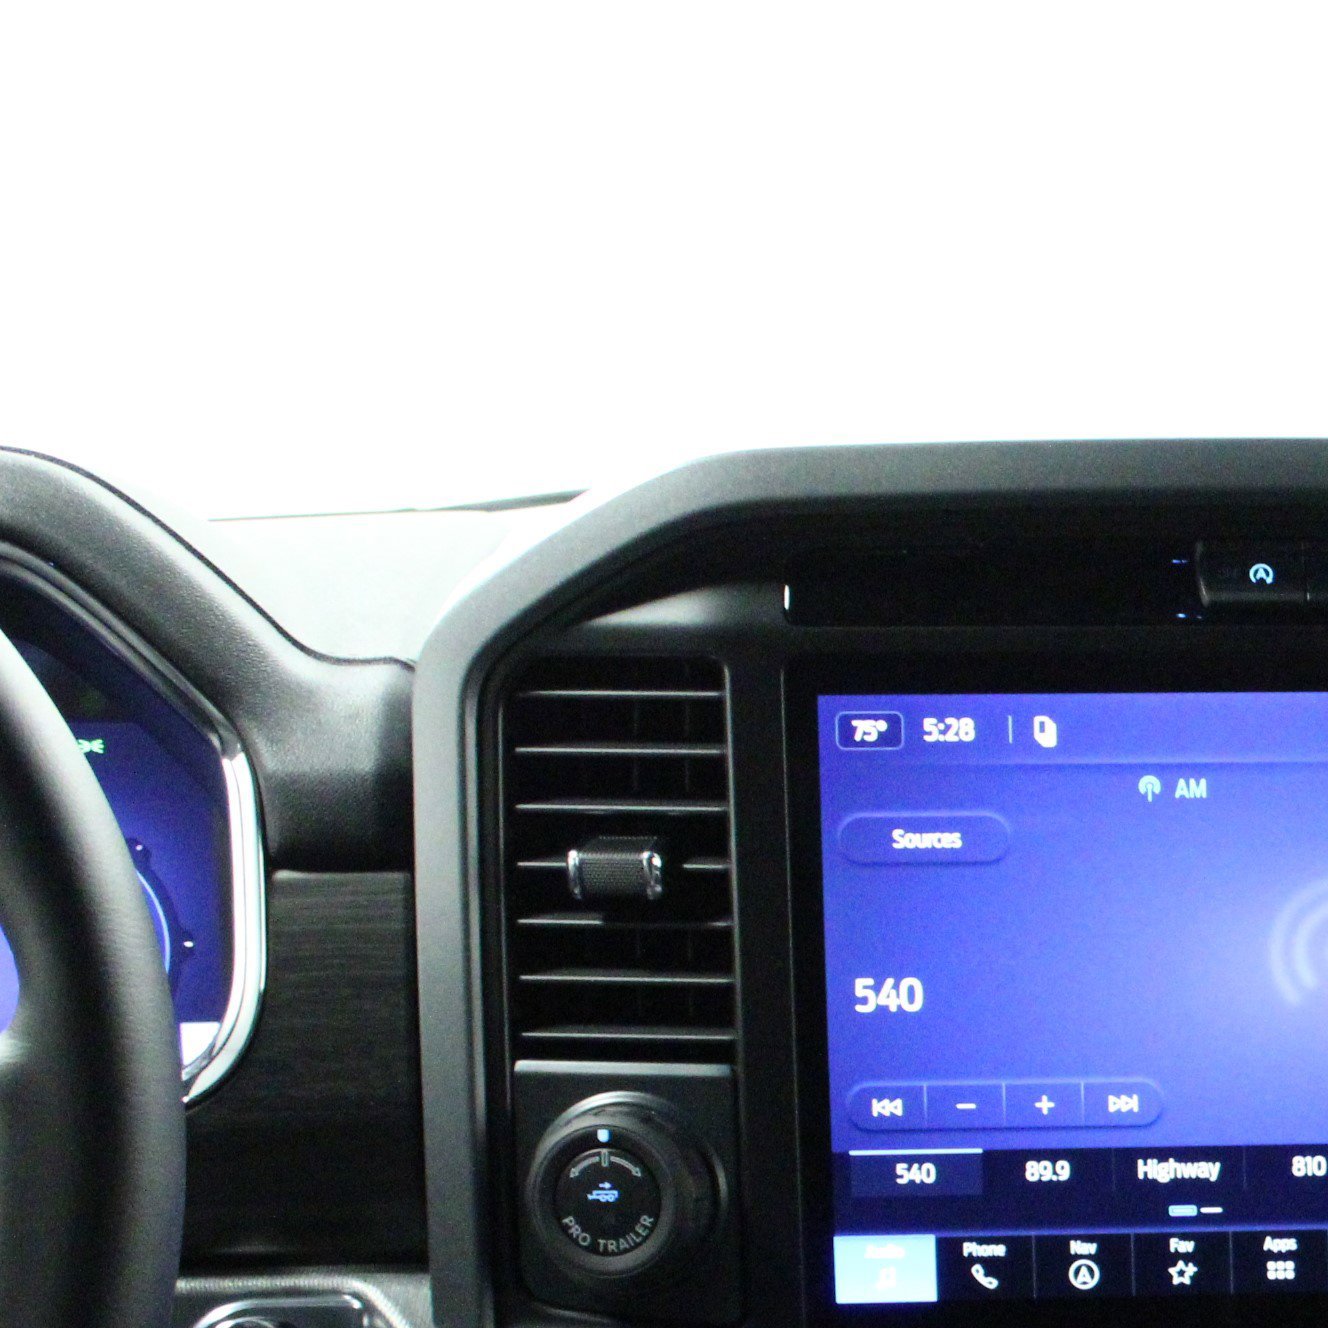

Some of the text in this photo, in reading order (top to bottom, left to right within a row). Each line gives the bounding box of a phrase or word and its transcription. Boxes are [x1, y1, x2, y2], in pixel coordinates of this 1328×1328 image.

[923, 718, 975, 742] 5:28
[1175, 779, 1207, 800] AM
[892, 829, 962, 850] Sources
[854, 976, 924, 1013] 540
[895, 1163, 937, 1184] 540
[1025, 1160, 1070, 1182] 89.9
[1137, 1158, 1221, 1183] Highway
[1291, 1155, 1327, 1177] 810
[561, 1214, 654, 1253] PRO TRAILER
[962, 1240, 1007, 1258] Phone
[1069, 1239, 1097, 1256] Nav
[1262, 1235, 1298, 1254] Apps
